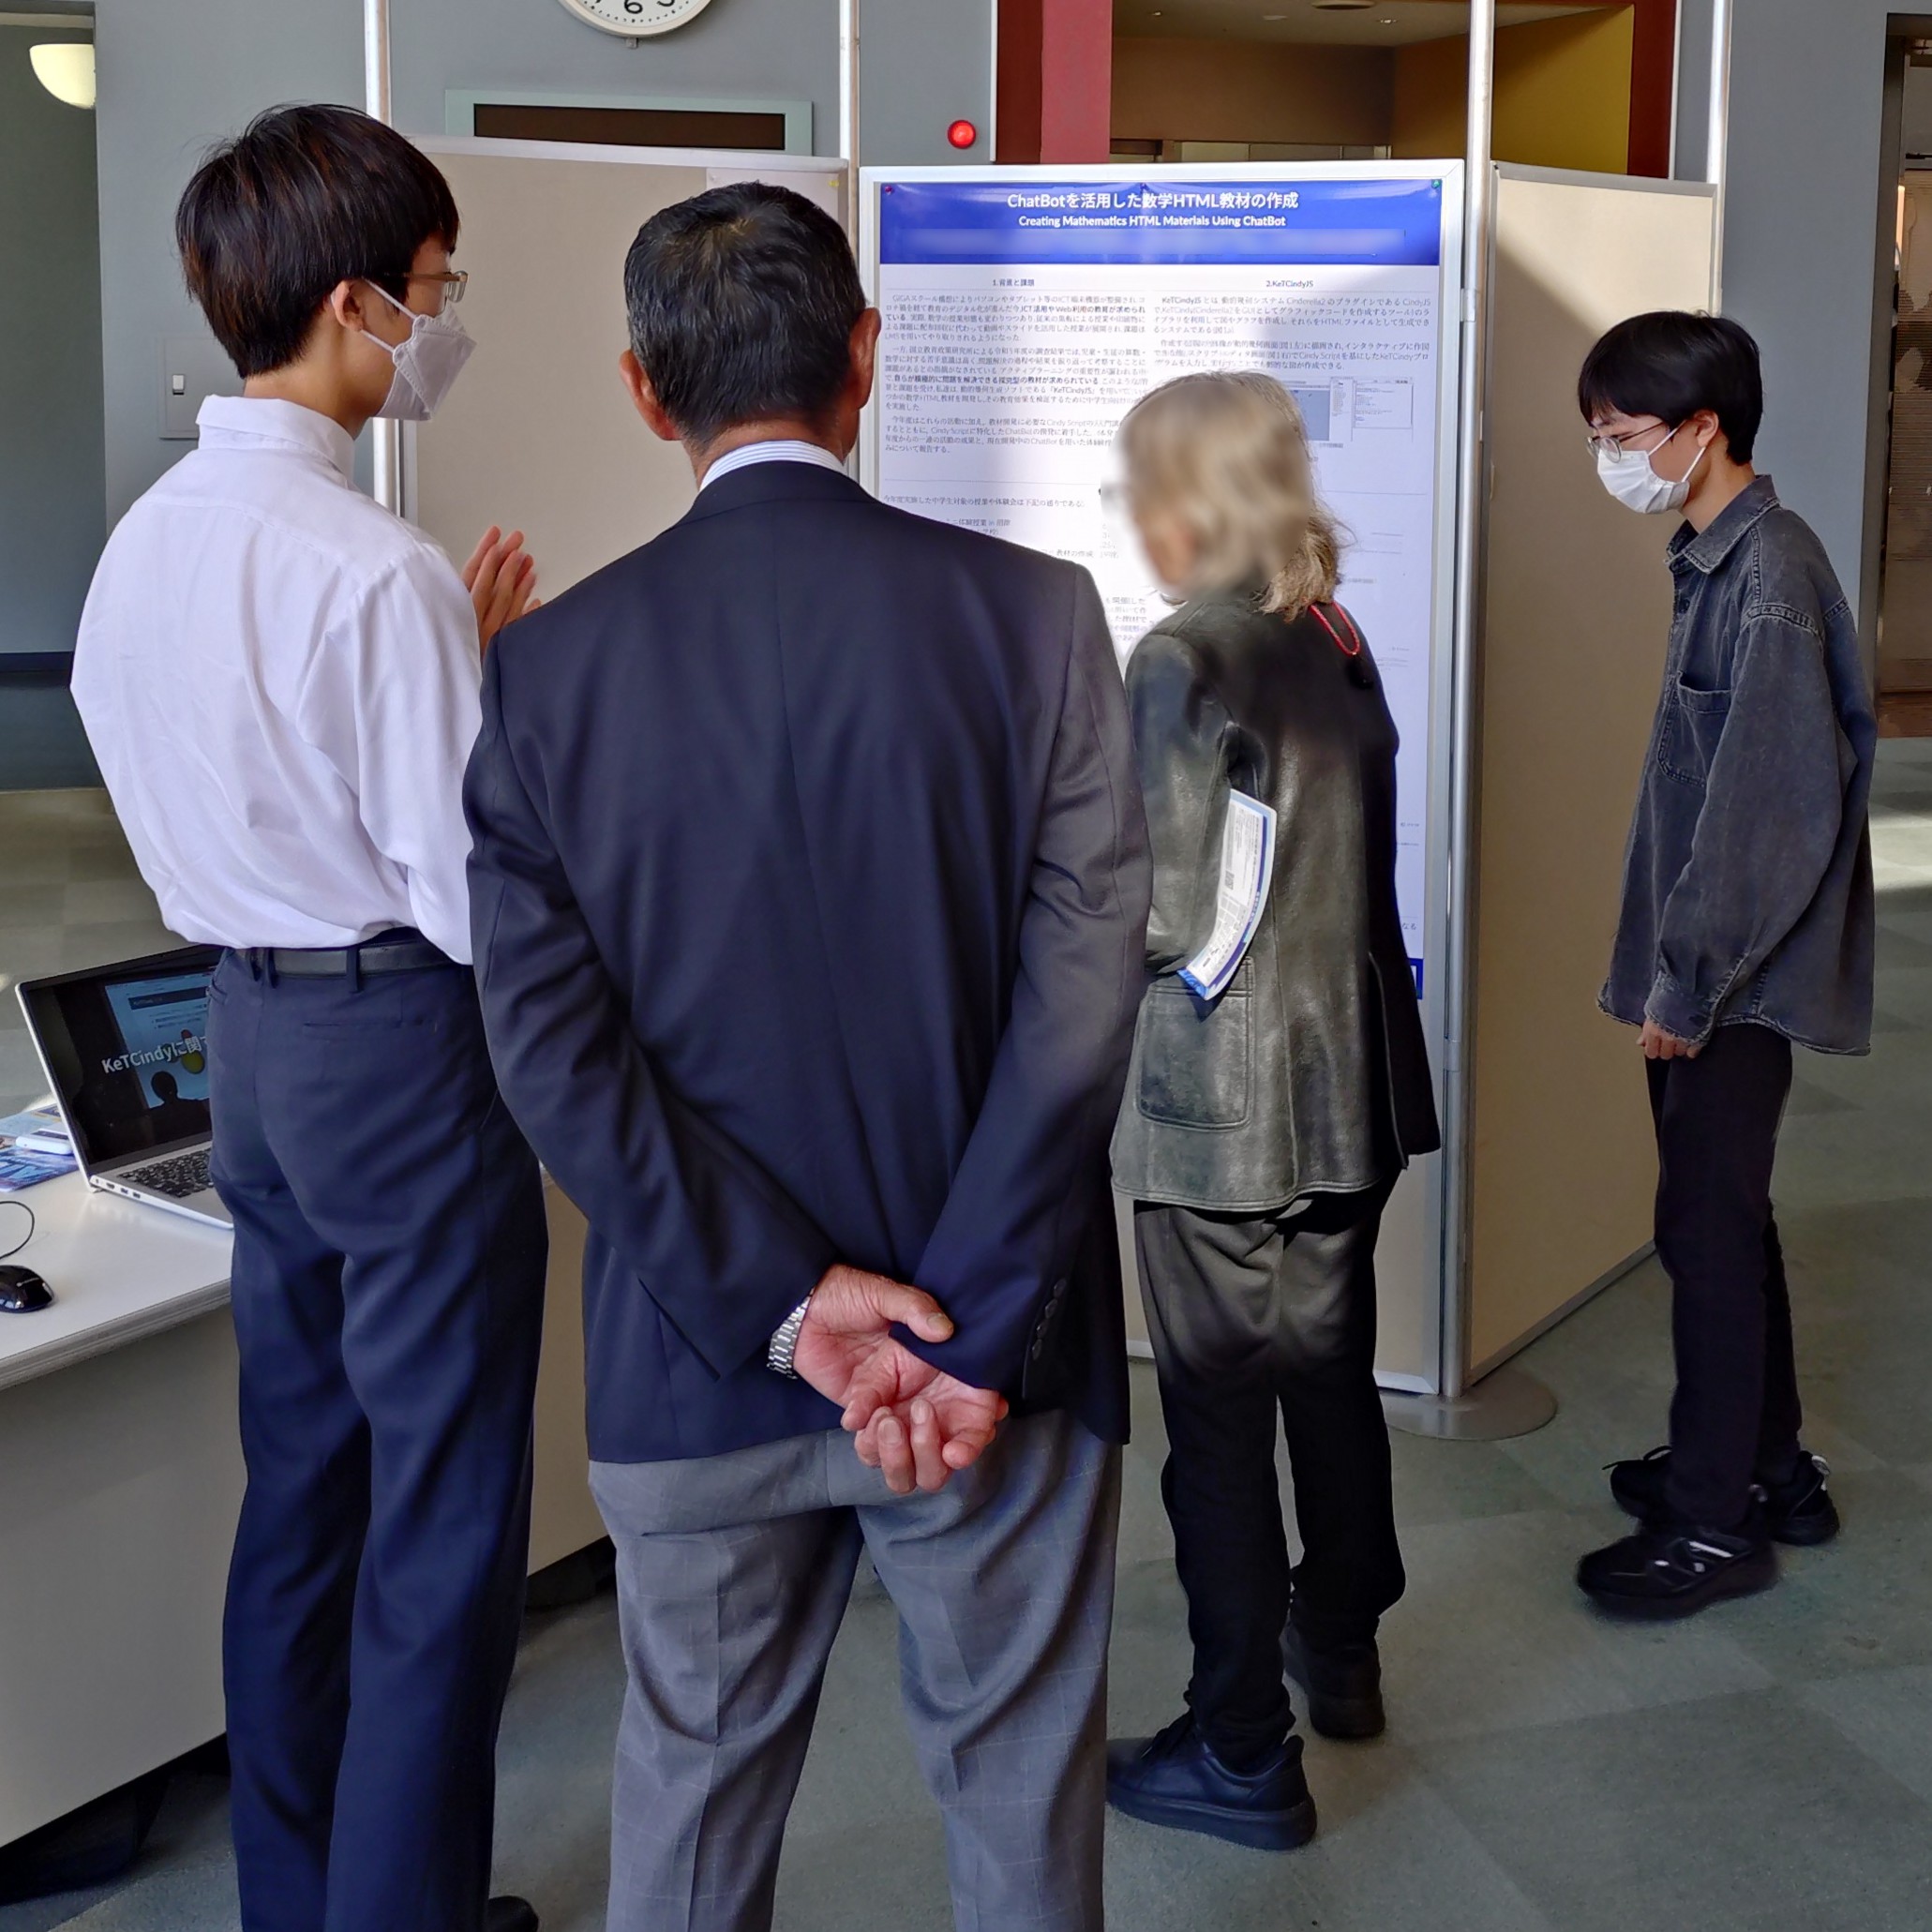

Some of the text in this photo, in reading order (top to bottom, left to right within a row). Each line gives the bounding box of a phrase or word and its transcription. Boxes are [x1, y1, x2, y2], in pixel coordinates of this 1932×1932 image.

[623, 0, 643, 14] 6
[1007, 191, 1299, 209] ChatBotを活用した数学HTML教材の作成
[1018, 216, 1286, 228] Creating Mathematics HTML Materials Using ChatBot
[1266, 279, 1314, 290] 2.KeTCindyJS
